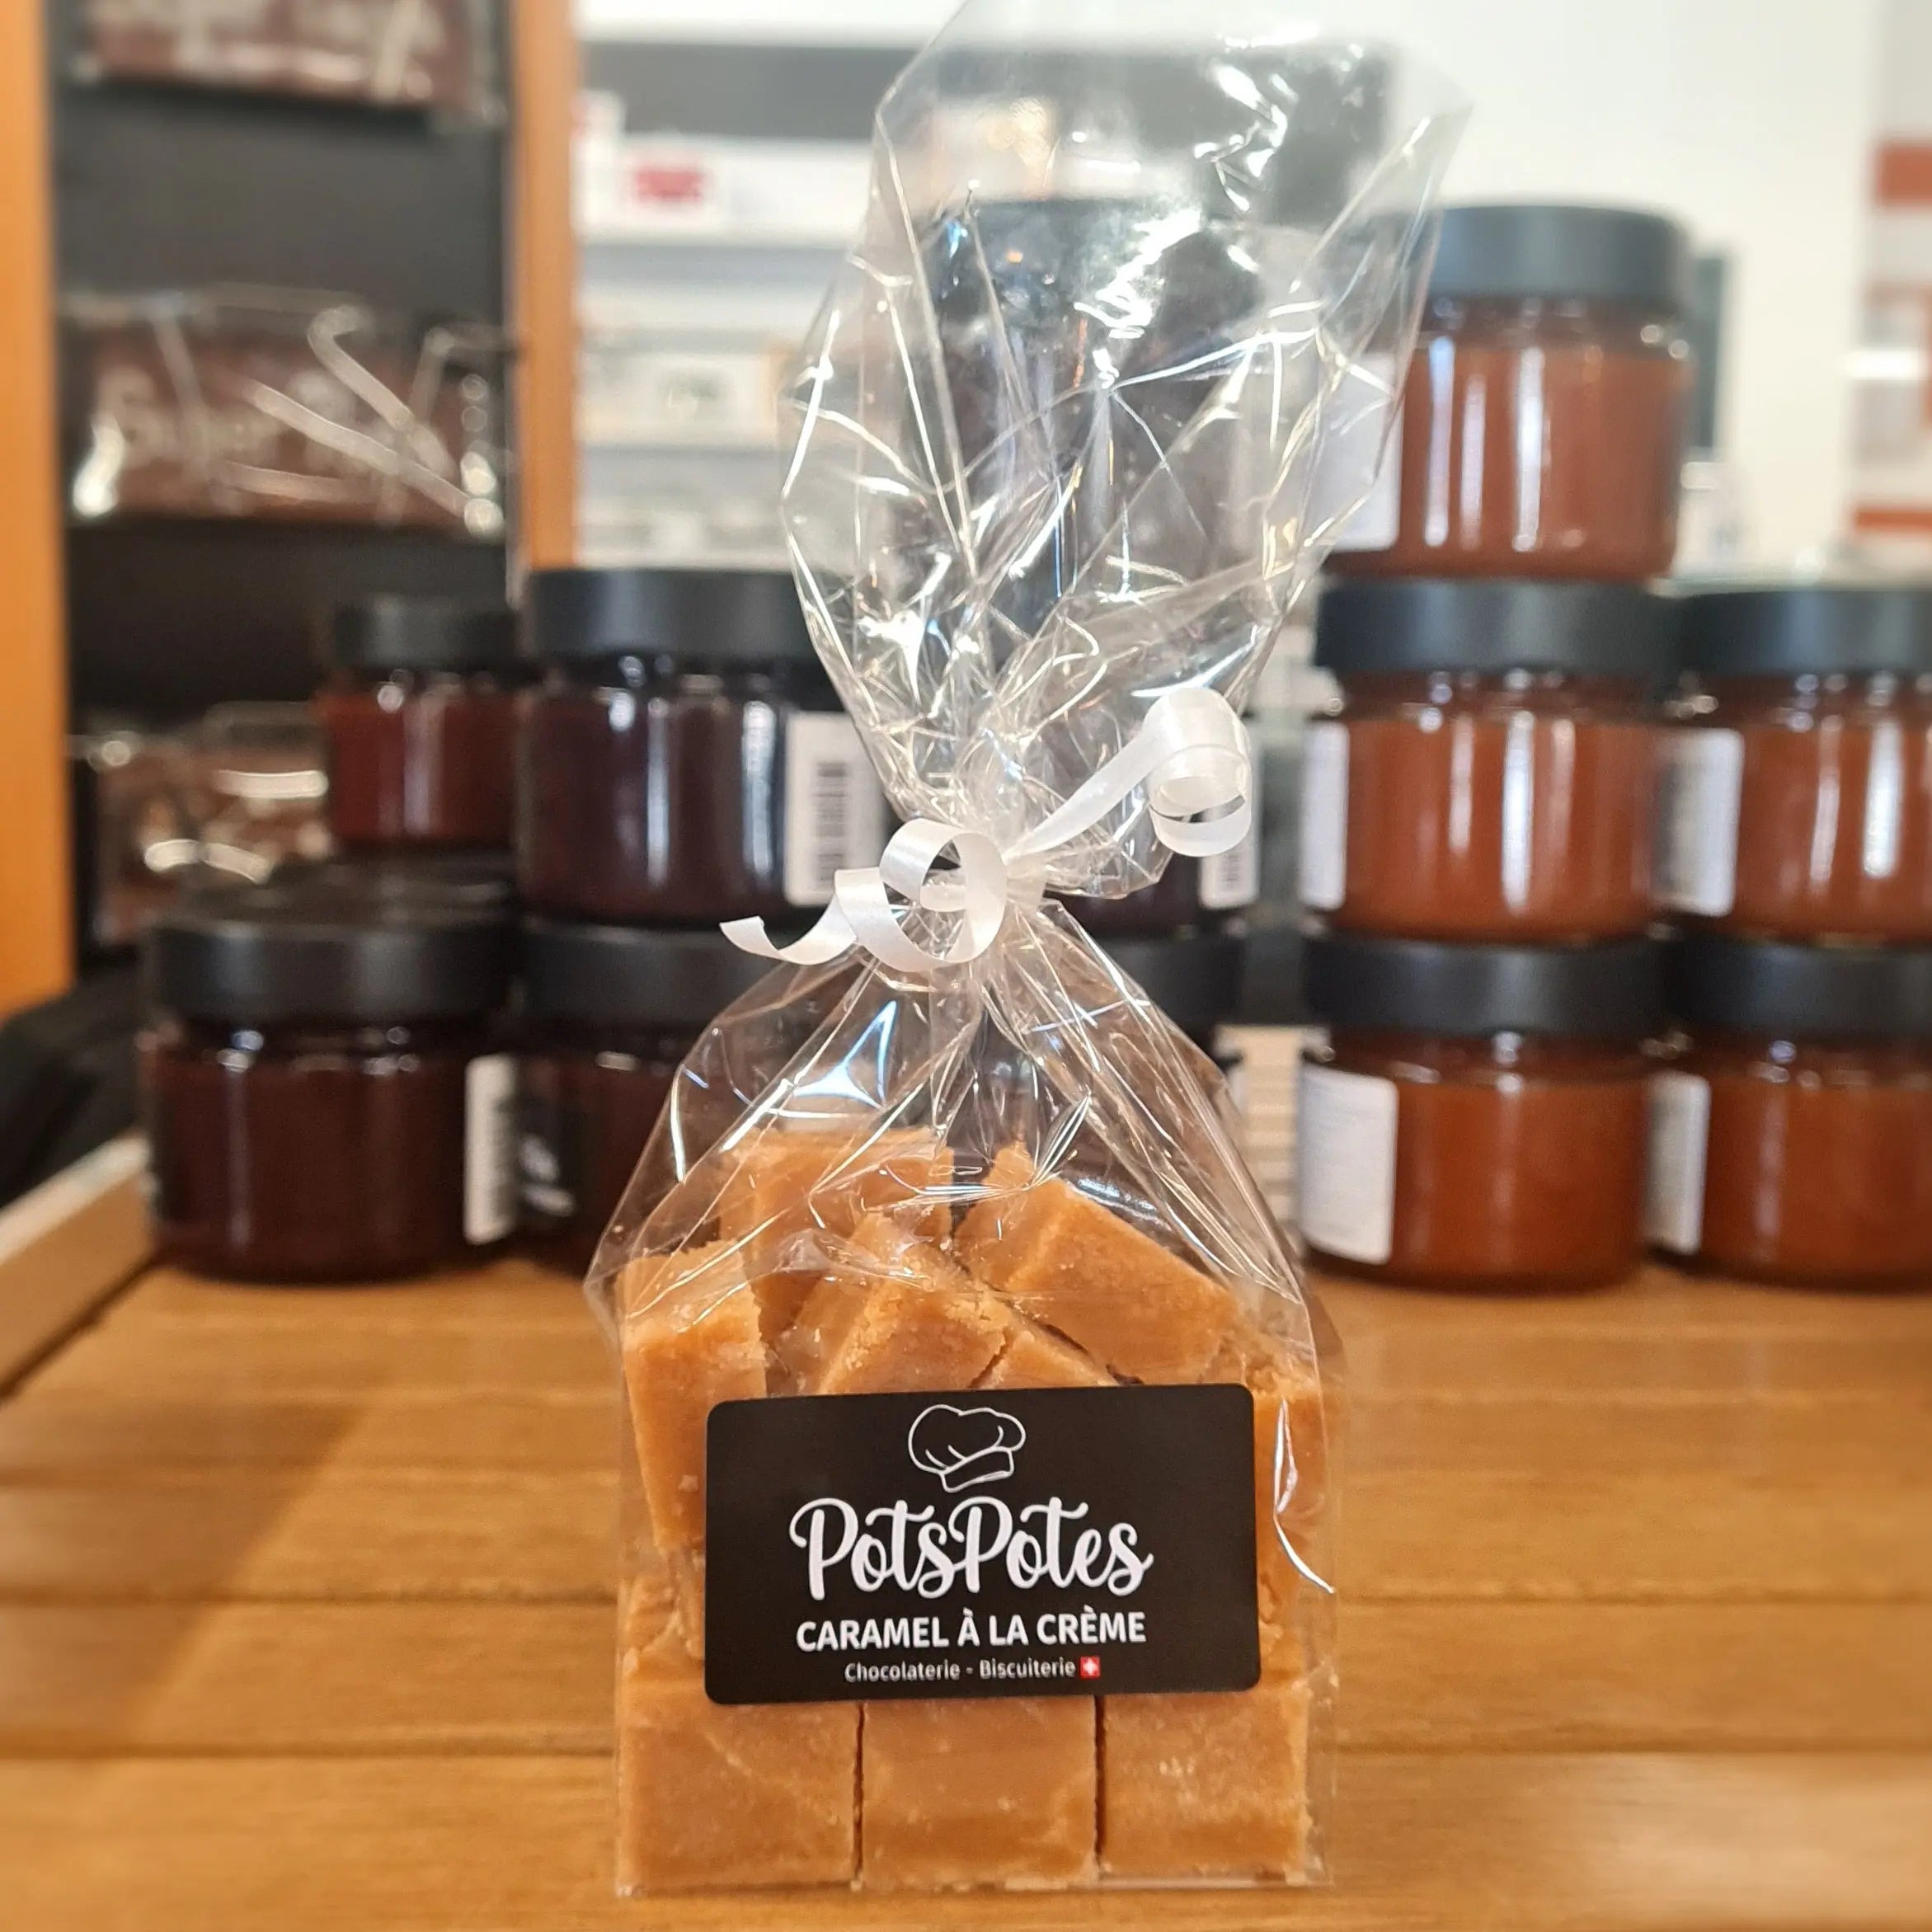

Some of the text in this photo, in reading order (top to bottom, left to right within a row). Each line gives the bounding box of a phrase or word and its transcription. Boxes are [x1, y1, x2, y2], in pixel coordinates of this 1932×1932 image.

[789, 1496, 1154, 1601] PotsPotes
[796, 1605, 1147, 1652] CARAMEL À LA CRÈME
[844, 1659, 961, 1681] Chocolaterie
[980, 1657, 1076, 1679] Biscuiterie
